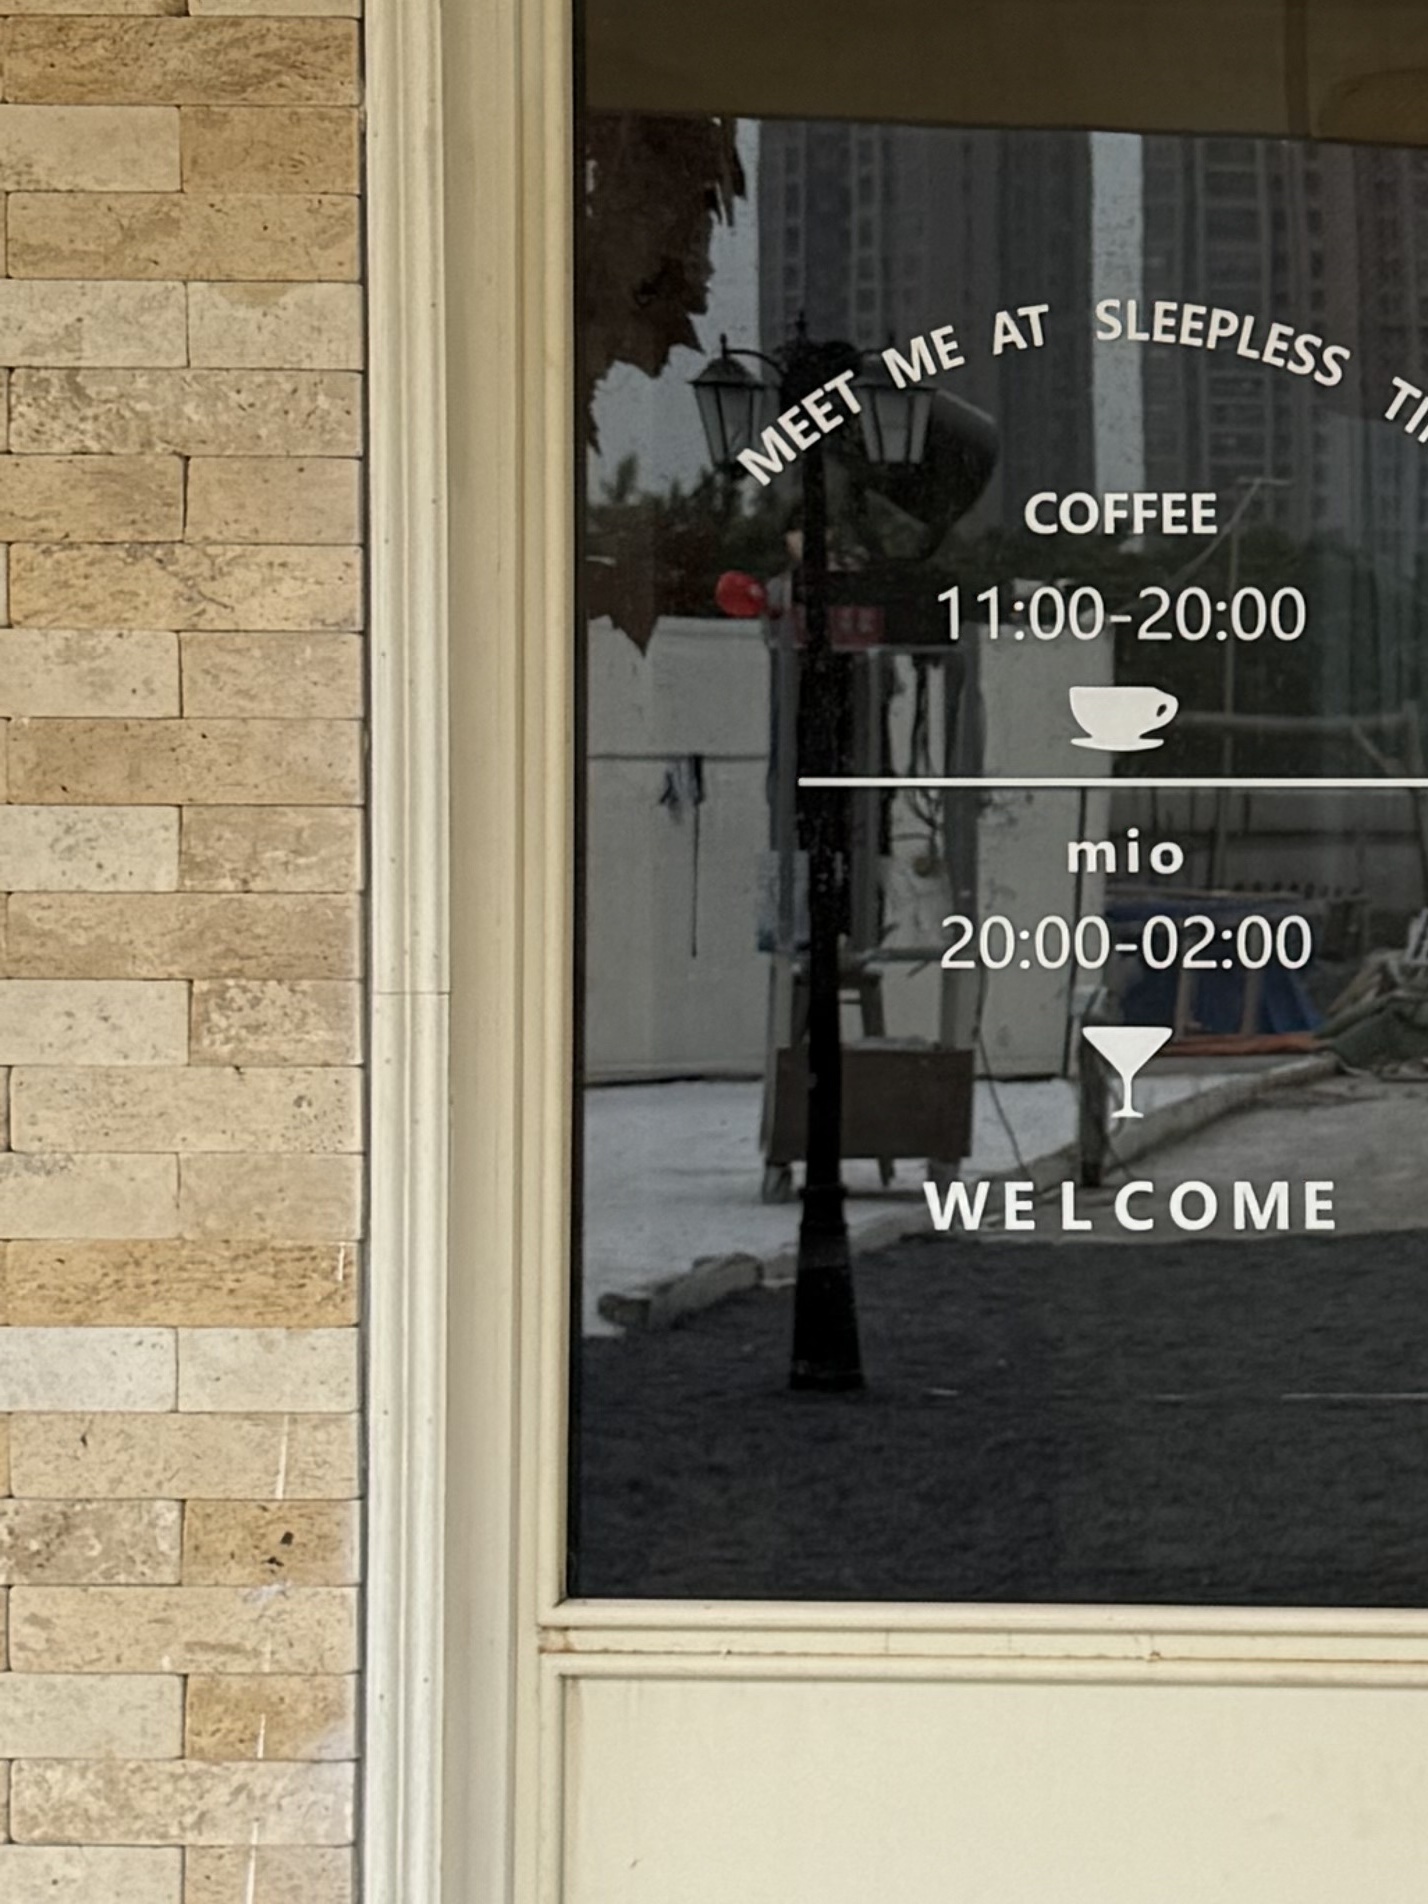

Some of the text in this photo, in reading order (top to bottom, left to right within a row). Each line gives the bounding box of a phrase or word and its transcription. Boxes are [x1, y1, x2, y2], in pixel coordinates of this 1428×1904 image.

[736, 371, 862, 486] MEET
[882, 326, 964, 388] ME
[994, 305, 1048, 354] AT
[1096, 299, 1350, 385] SLEEPLESS
[1025, 493, 1217, 533] COFFEE
[939, 587, 1305, 640] 11:00-20:00
[1068, 828, 1183, 873] mio
[941, 916, 1310, 969] 20:00-02:00
[923, 1181, 1334, 1230] WELCOME
